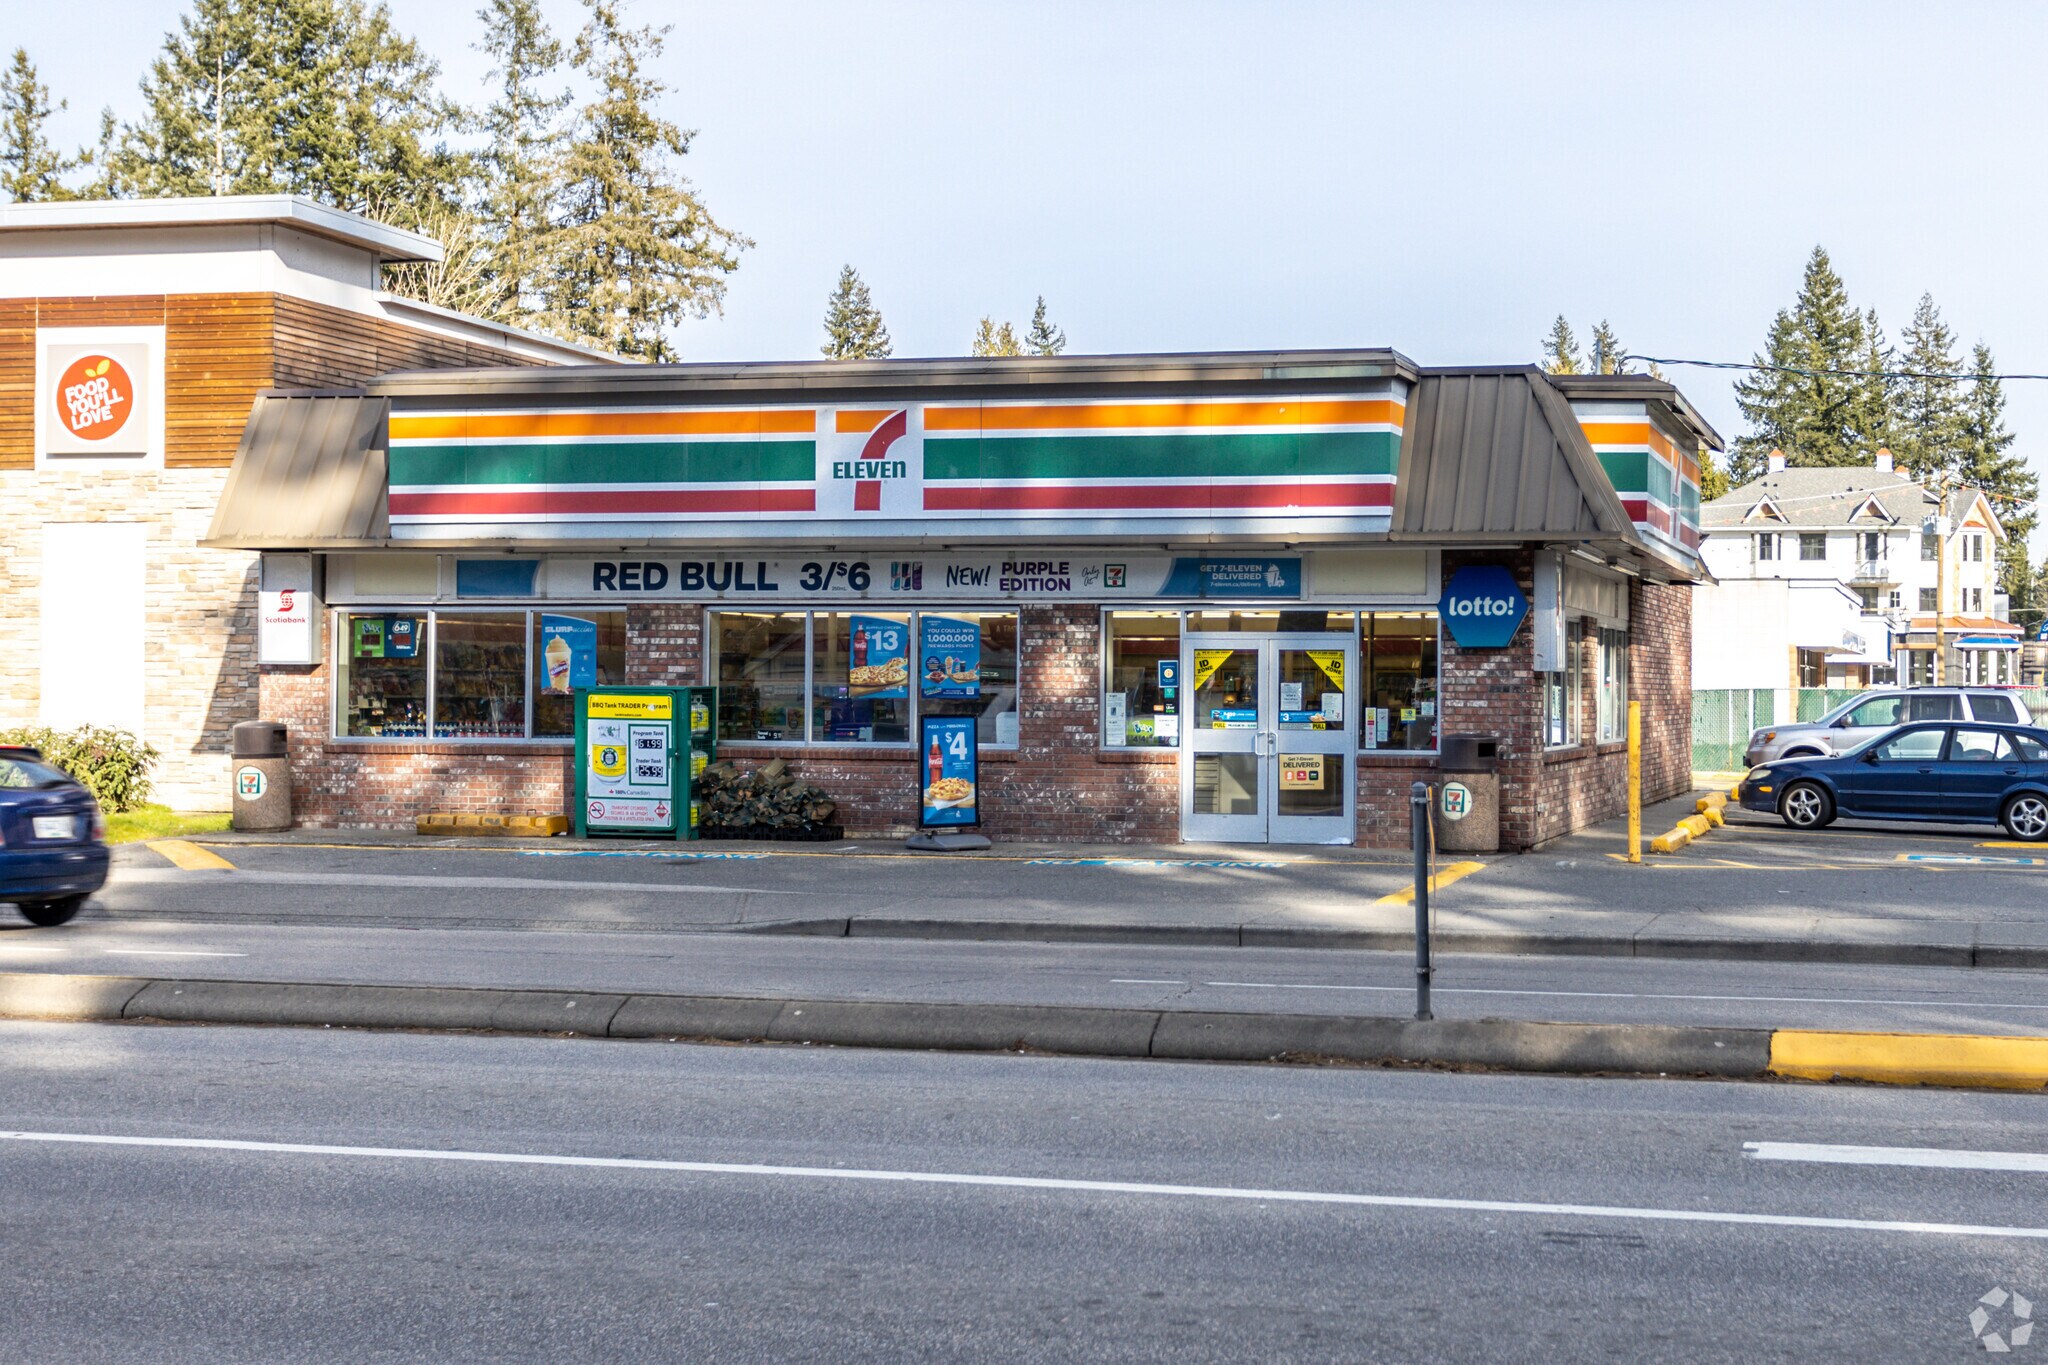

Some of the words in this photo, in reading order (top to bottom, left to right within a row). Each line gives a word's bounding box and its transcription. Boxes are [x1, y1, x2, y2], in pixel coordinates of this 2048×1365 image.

[65, 377, 109, 403] FOOD
[67, 388, 124, 416] YOU'LL
[71, 404, 114, 430] LOVE
[593, 562, 669, 591] RED
[680, 562, 779, 591] BULL
[800, 562, 871, 591] 3/$6
[946, 565, 991, 588] NEW!
[1001, 562, 1070, 575] PURPLE
[1220, 564, 1262, 572] 7-ELEVEN
[1000, 577, 1071, 592] EDITION
[1449, 596, 1515, 616] lotto!
[865, 630, 899, 651] $13
[927, 634, 975, 643] 1,000,000
[1197, 665, 1213, 674] ZONE
[1199, 659, 1209, 668] ID
[1325, 666, 1342, 675] ZONE
[1331, 660, 1341, 669] ID
[945, 732, 968, 760] $4
[244, 776, 256, 793] 7
[1448, 792, 1461, 811] 7
